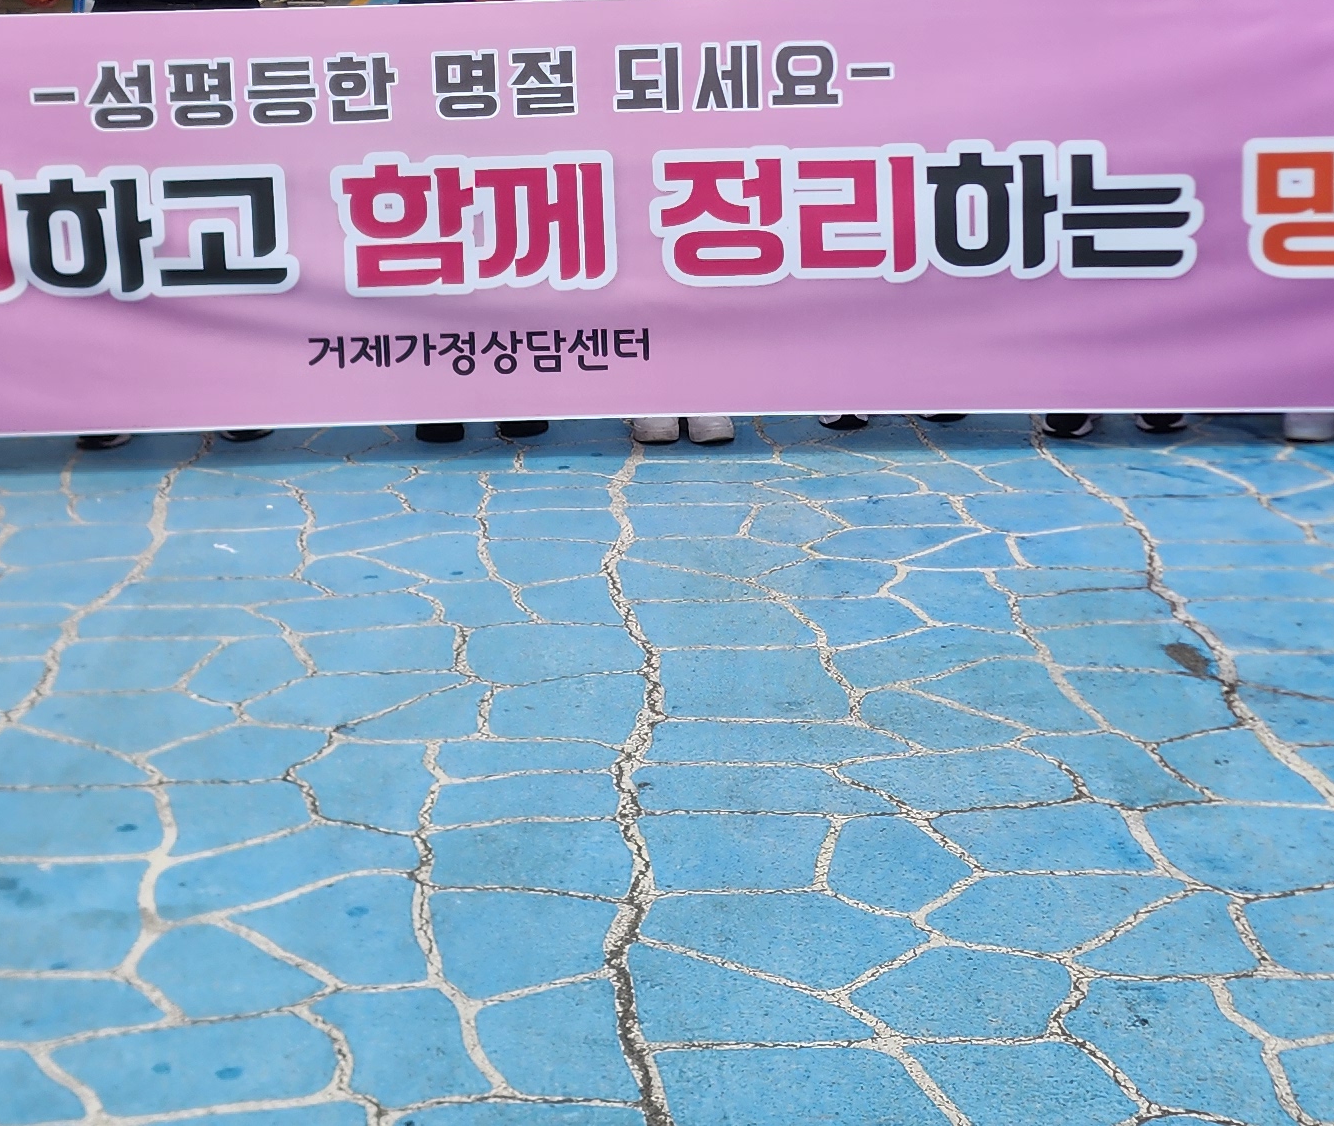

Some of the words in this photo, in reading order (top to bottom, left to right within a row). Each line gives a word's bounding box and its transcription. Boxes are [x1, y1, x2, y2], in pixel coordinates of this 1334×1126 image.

[431, 47, 577, 120] 명절
[331, 151, 616, 297] 함께
[652, 140, 1202, 287] 정리하는
[308, 327, 651, 375] 거제가정상담센터
